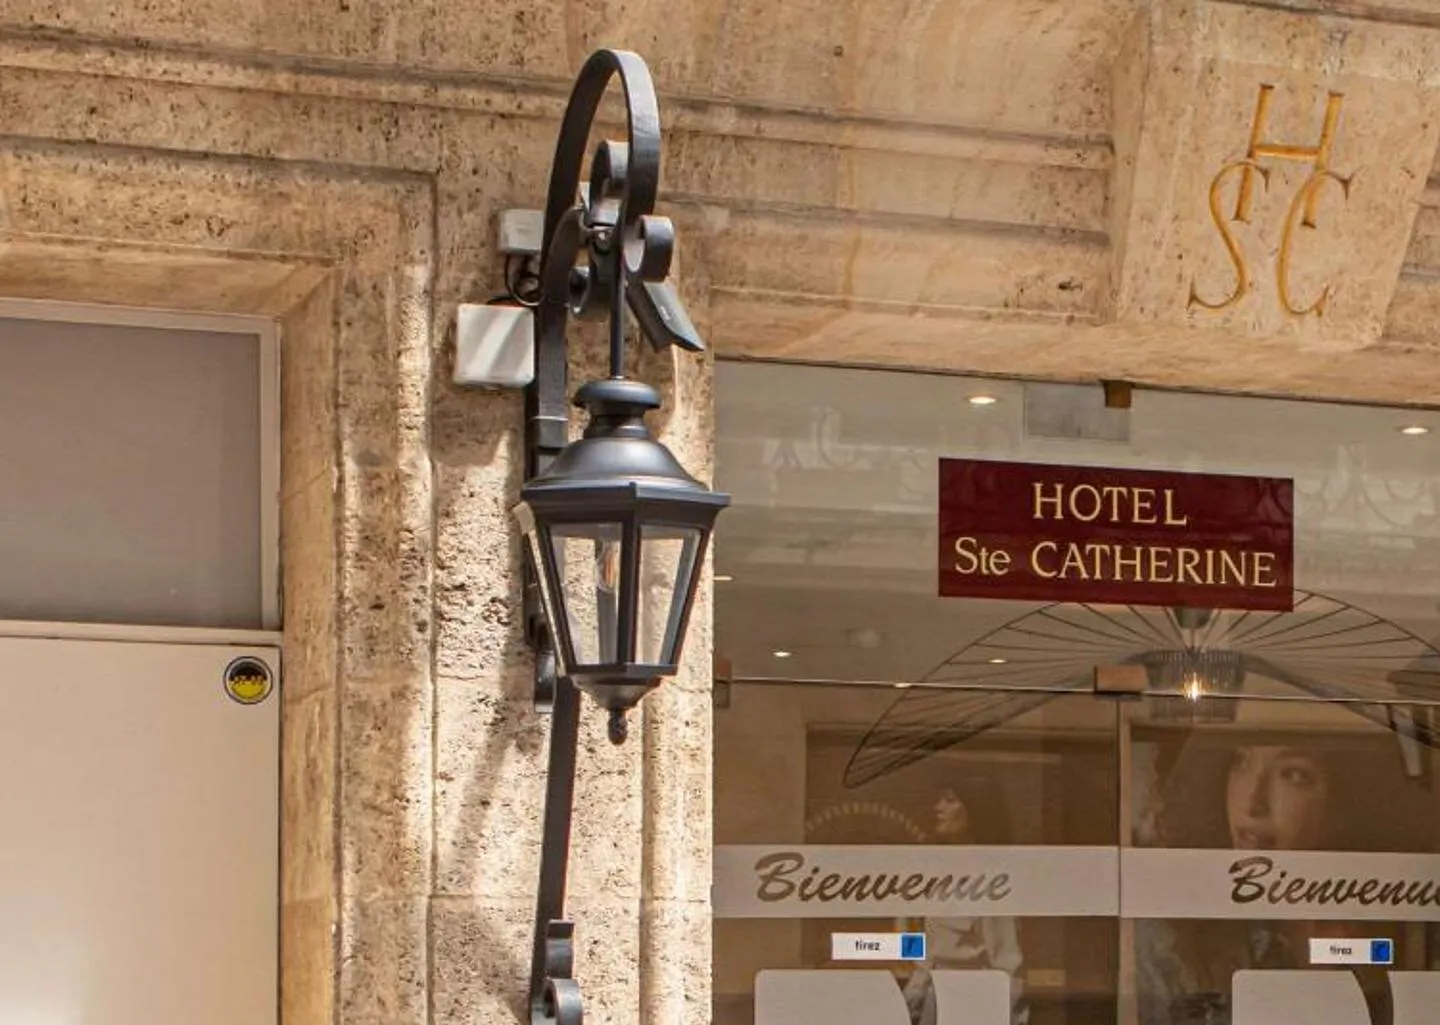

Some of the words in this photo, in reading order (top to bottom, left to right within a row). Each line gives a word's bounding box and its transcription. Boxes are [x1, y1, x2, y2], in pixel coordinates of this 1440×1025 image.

[1031, 482, 1188, 526] HOTEL
[954, 537, 1011, 576] Ste
[1031, 541, 1277, 588] CATHERINE
[754, 852, 1012, 902] Bienvenue
[855, 940, 881, 951] tirez
